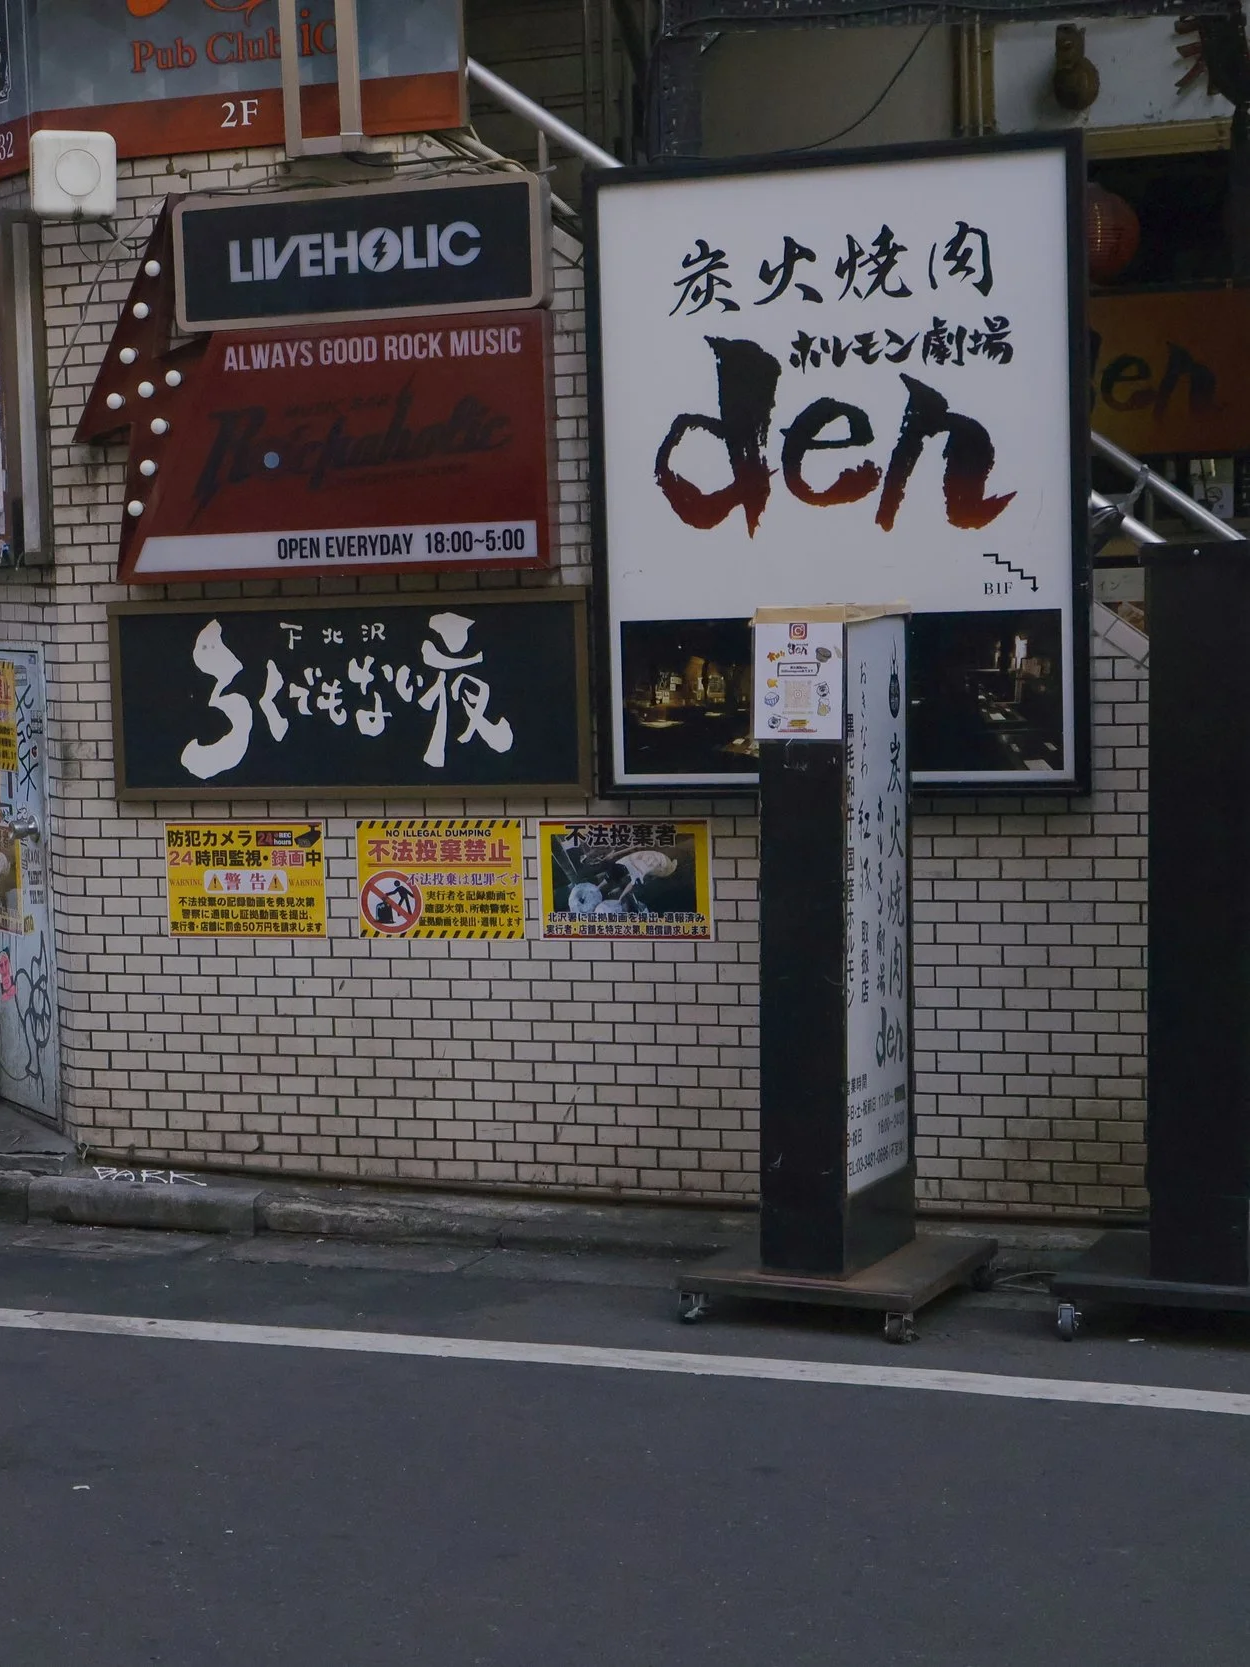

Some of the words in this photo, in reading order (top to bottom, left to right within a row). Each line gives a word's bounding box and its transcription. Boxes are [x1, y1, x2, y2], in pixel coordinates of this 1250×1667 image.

[131, 37, 197, 73] Pub
[220, 99, 259, 128] 2F
[228, 221, 482, 283] LIVEHOLIC
[669, 220, 994, 317] 炭火焼肉
[224, 340, 313, 371] ALWAYS
[319, 336, 379, 365] GOOD
[384, 331, 444, 361] ROCK
[450, 327, 522, 357] MUSIC
[789, 316, 1015, 373] ホルモン劇場
[1090, 327, 1222, 420] en
[654, 334, 1018, 539] den
[277, 537, 320, 560] OPEN
[325, 533, 413, 557] EVERYDAY
[424, 528, 525, 555] 18:00~5:00
[983, 581, 1014, 596] B1F
[279, 622, 386, 651] 下北沢
[180, 611, 514, 780] ろくでもない夜
[167, 830, 252, 847] 防犯カメラ
[258, 833, 274, 845] 24
[385, 830, 400, 838] NO
[403, 829, 442, 838] ILLEGAL
[445, 829, 492, 838] DUMPING
[565, 824, 677, 847] 不法投棄者
[168, 850, 322, 867] 24時間監視・録画中
[367, 838, 512, 863] 不法投棄禁止
[408, 872, 521, 886] 不法投棄は犯罪です
[887, 732, 904, 999] 炭火焼肉
[170, 878, 202, 886] WARNING
[224, 872, 266, 891] 警告
[289, 878, 323, 887] WARNING
[178, 896, 315, 908] 不法投棄の記録動画を発見次第
[426, 890, 517, 901] 実行者を記録動画で
[875, 1005, 904, 1069] den
